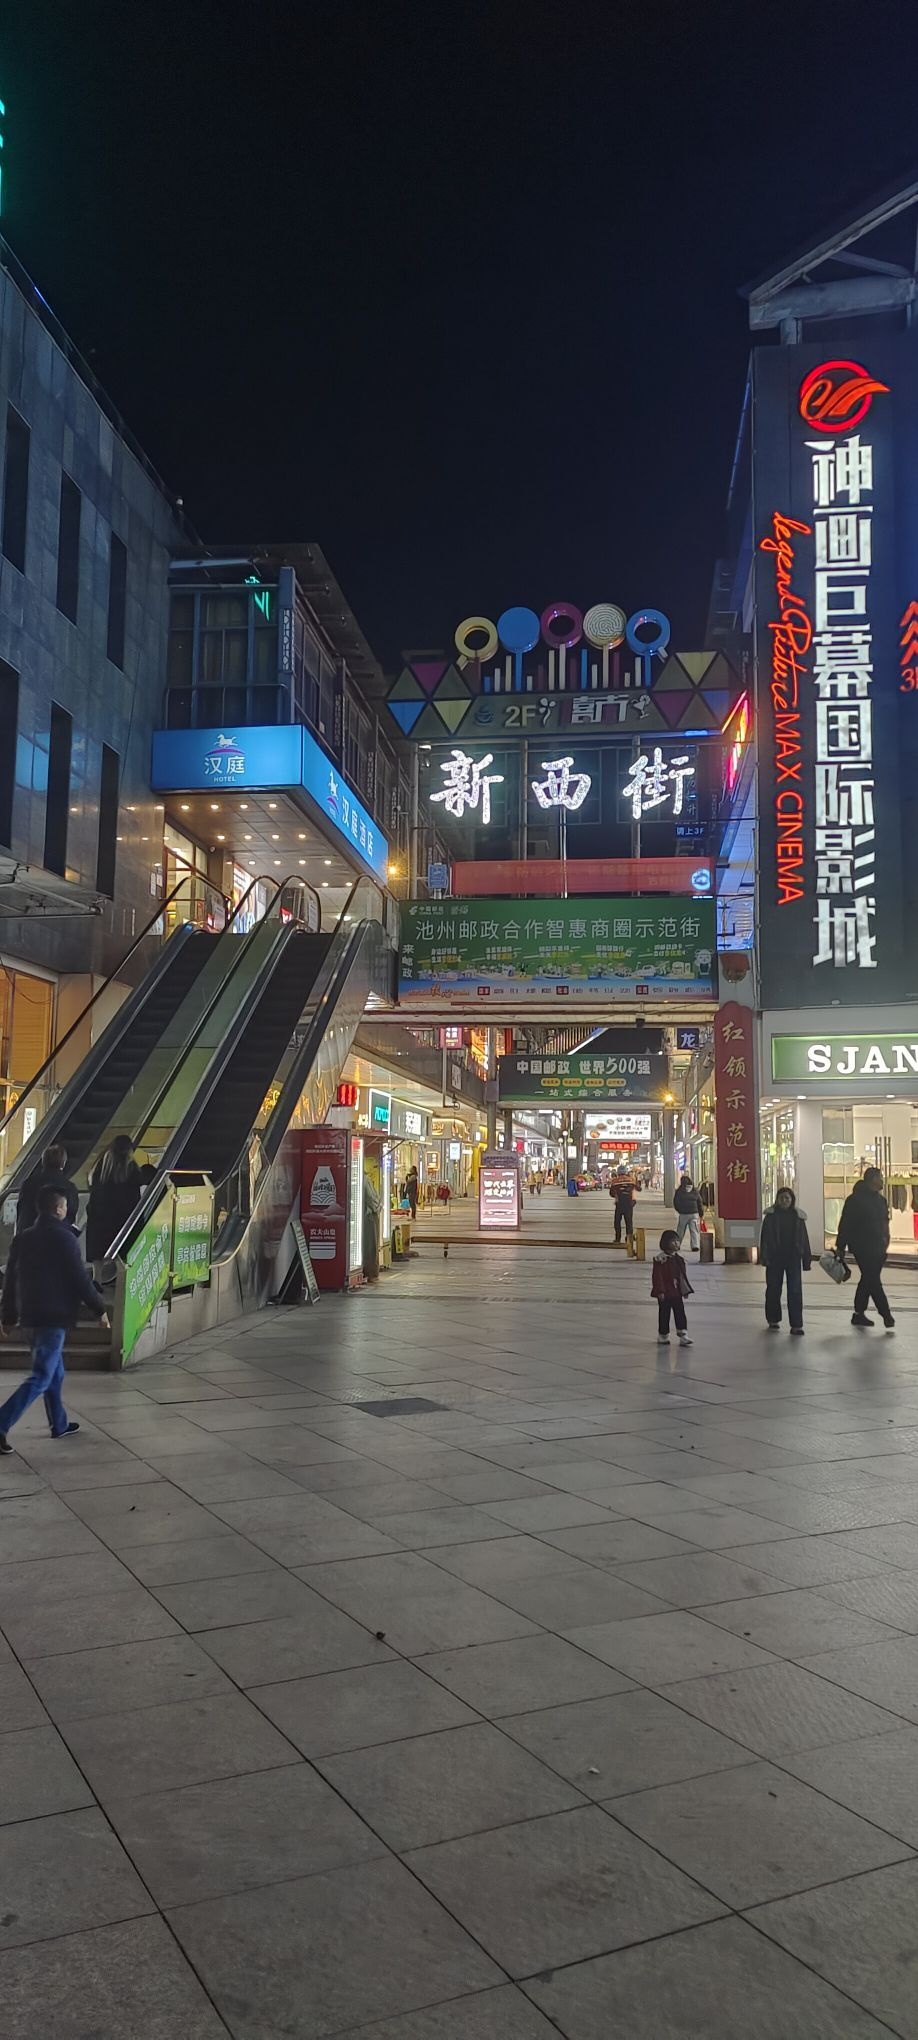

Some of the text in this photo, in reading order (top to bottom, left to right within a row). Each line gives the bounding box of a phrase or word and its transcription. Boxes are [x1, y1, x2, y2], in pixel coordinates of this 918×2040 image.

[899, 667, 918, 692] 3
[504, 704, 537, 728] 2F
[805, 435, 876, 968] 神画巨幕国际影城
[774, 712, 801, 783] MAX
[204, 756, 246, 774] 汉庭
[430, 747, 695, 824] 新西街
[774, 791, 803, 905] CINEMA
[415, 917, 701, 941] 池州邮政合作智惠商圈示范街
[516, 1056, 651, 1075] 中国邮政 世界500强
[807, 1043, 918, 1074] SJAN
[722, 1022, 750, 1183] 红领示范街
